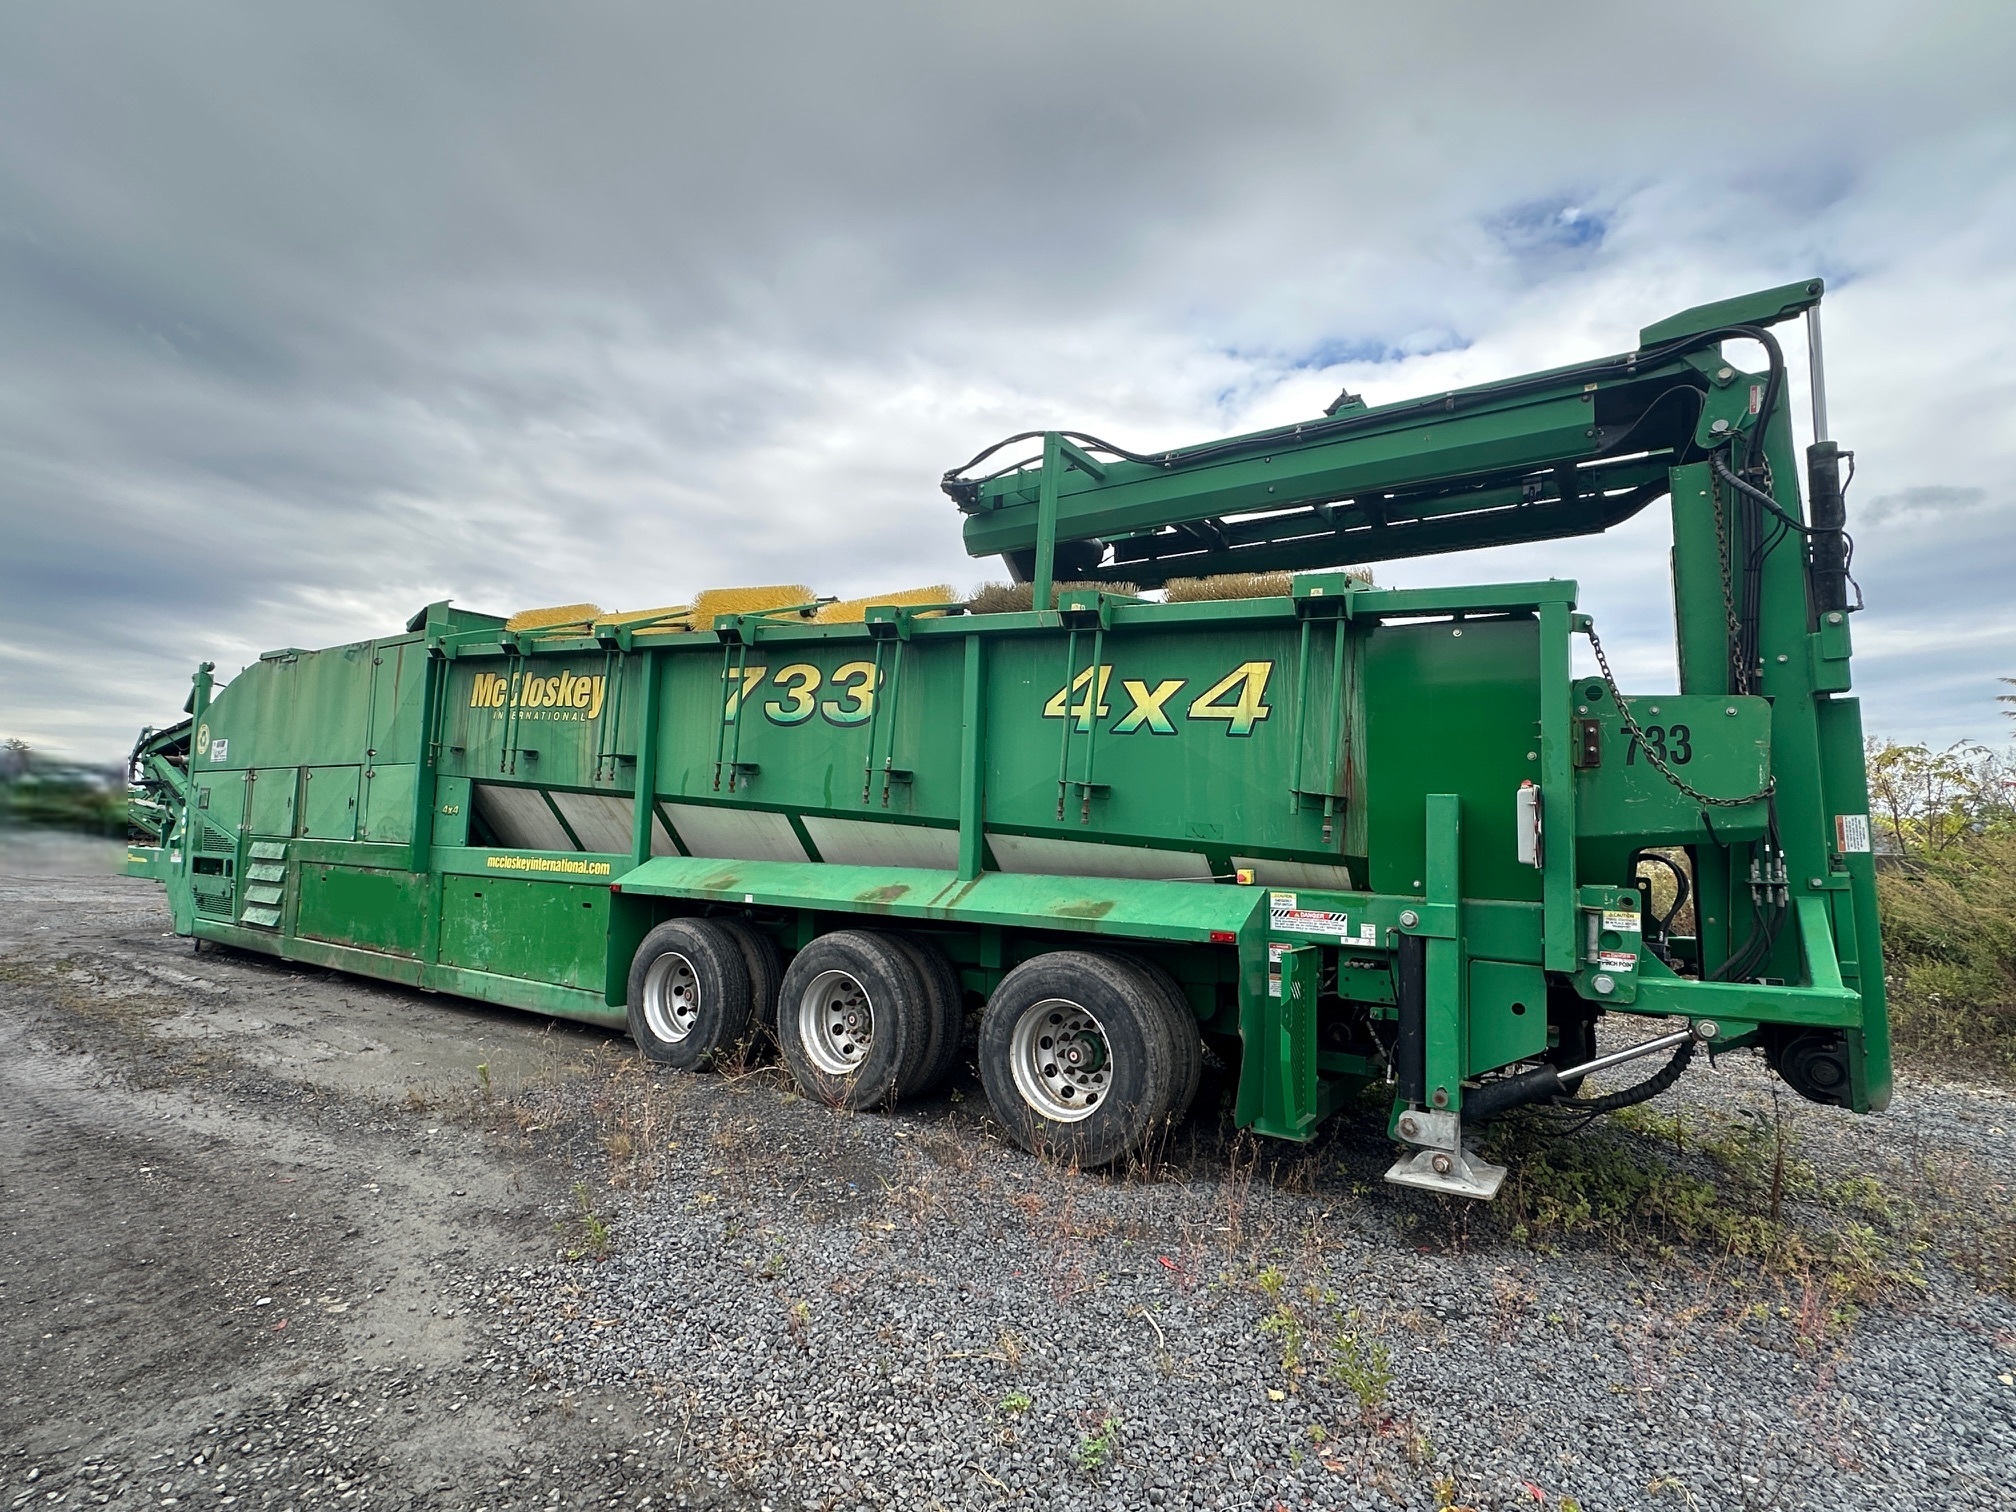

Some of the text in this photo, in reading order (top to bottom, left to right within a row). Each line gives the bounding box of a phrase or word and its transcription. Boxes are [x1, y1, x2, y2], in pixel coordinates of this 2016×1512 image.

[721, 661, 885, 728] 733
[1042, 659, 1275, 737] 4x4
[493, 711, 586, 721] INERNATIONAL
[1620, 725, 1692, 766] 733
[442, 804, 459, 815] 4x4
[487, 855, 610, 875] mccloskeyinternational.com
[1300, 911, 1325, 919] DANGER
